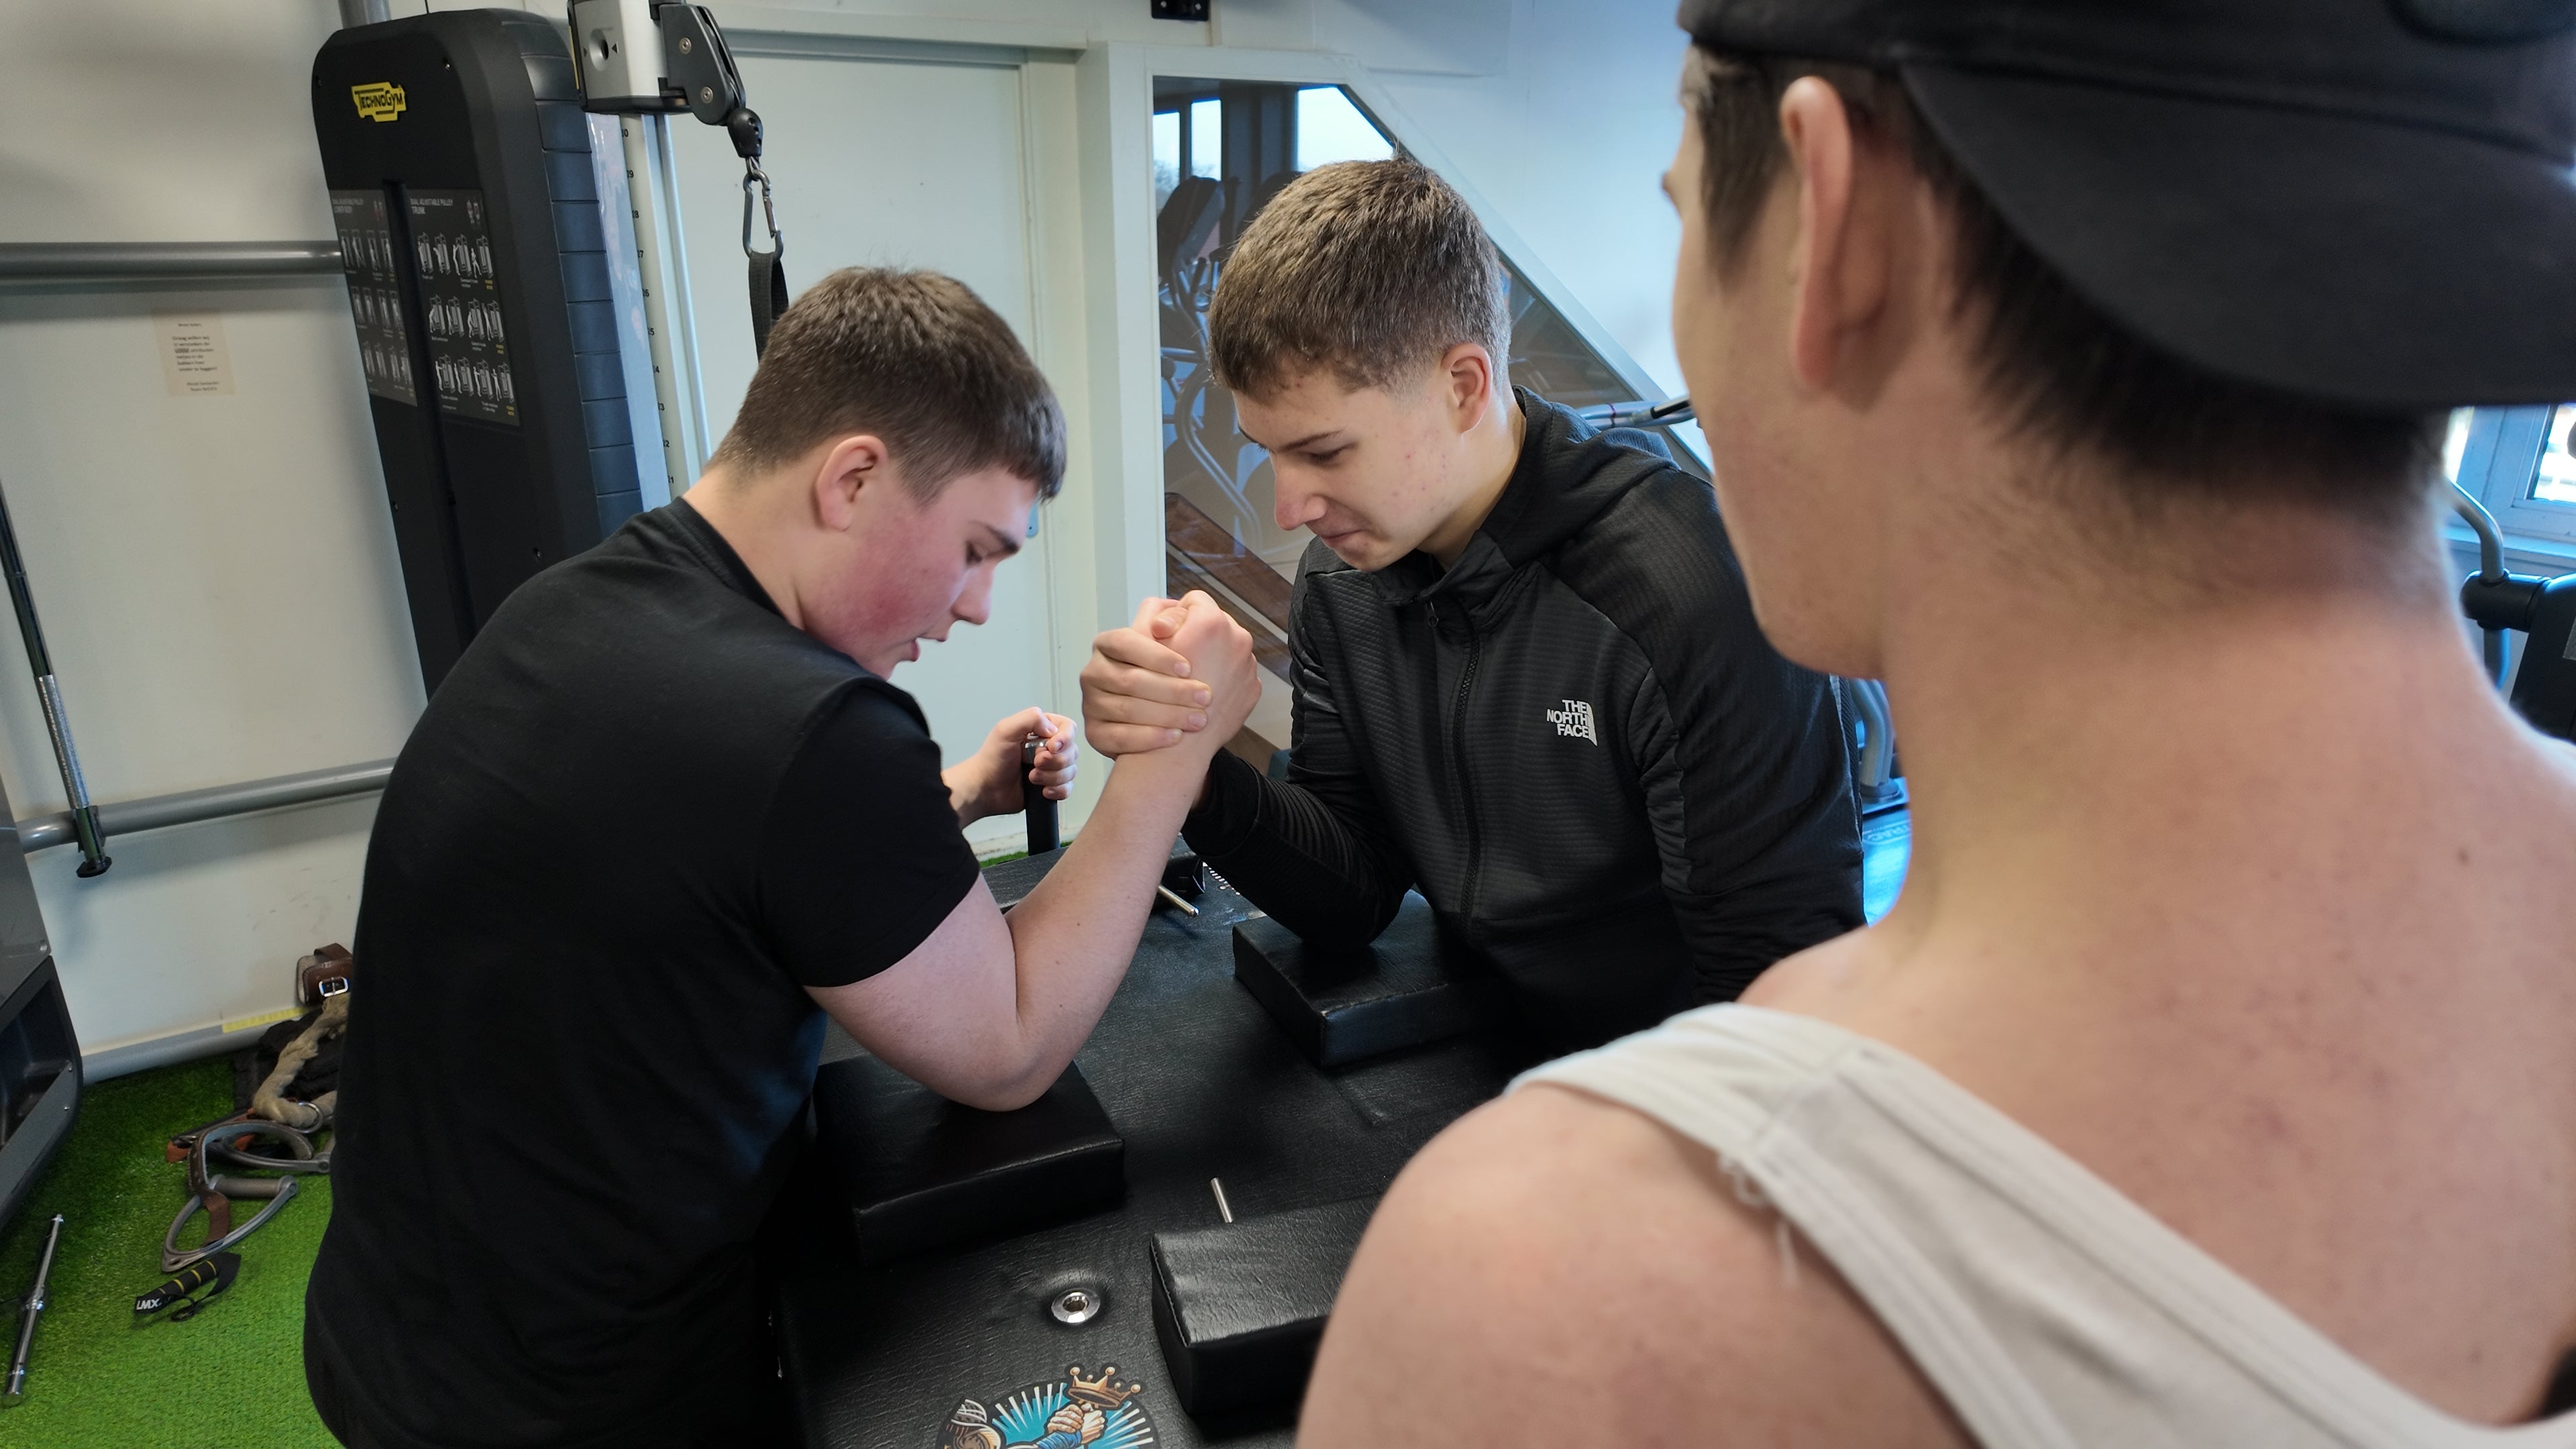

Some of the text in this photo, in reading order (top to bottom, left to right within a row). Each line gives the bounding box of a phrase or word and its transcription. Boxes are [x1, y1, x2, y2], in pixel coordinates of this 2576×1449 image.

[1562, 699, 1587, 714] THE
[1546, 708, 1589, 726] NORTH
[1557, 724, 1590, 739] FACE
